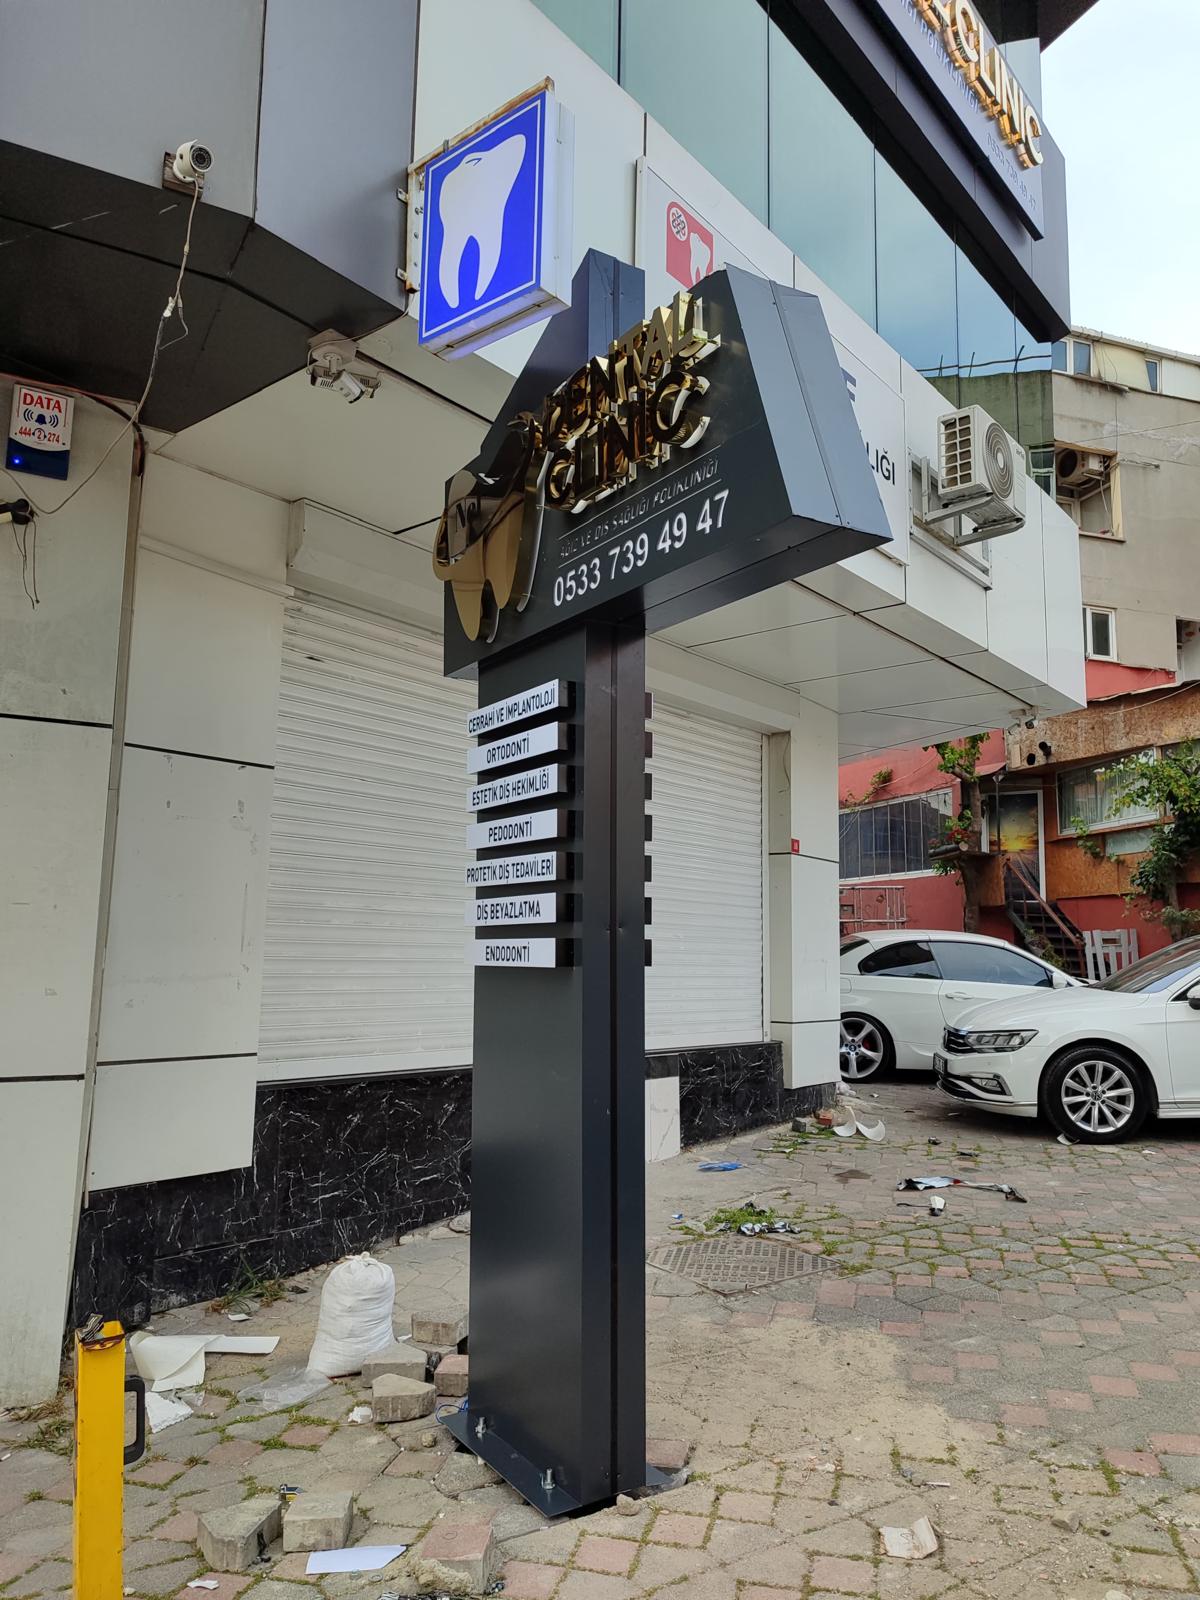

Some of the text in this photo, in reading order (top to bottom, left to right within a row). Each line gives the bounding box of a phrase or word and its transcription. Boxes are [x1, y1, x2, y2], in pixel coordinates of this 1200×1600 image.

[951, 0, 1044, 166] CLINIC
[23, 392, 62, 414] DATA
[18, 426, 32, 438] 444
[47, 431, 60, 444] 274
[553, 488, 730, 607] 0533 739 49 47
[496, 707, 505, 723] VE
[505, 683, 556, 721] İMPLANTOLOJİ
[486, 733, 530, 764] ORTODONTİ
[472, 768, 550, 806] ESTETİK DİŞ HEKİMLİĞİ
[488, 817, 533, 843] PEDODONTİ
[466, 855, 554, 884] PROTETİK DİŞ TEDAVİLERİ
[476, 899, 541, 924] DİŞ BEYAZLATMA
[485, 941, 530, 963] ENDODONTİ
